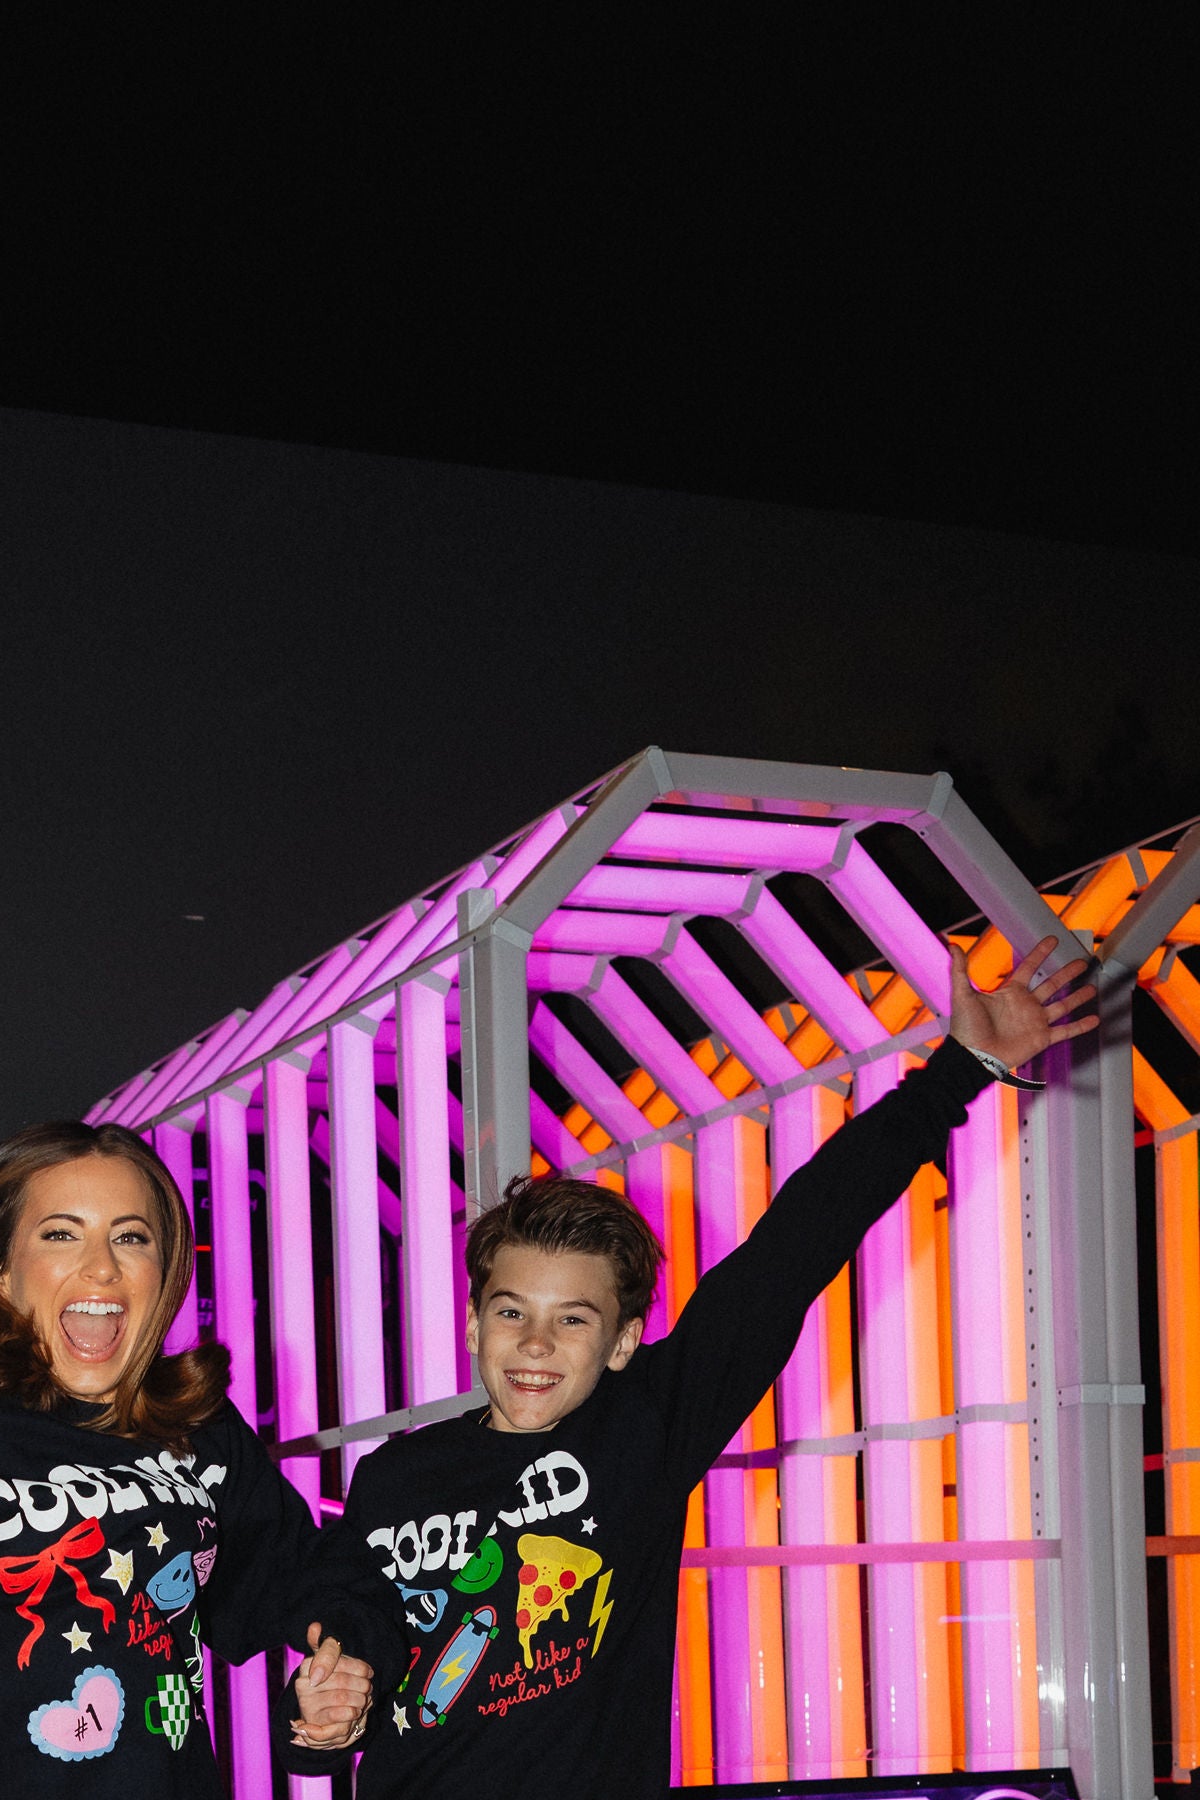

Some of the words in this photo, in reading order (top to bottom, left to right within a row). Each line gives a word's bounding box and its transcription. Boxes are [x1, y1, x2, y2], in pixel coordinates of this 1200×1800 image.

[534, 1640, 571, 1675] like
[576, 1637, 589, 1651] a
[478, 1681, 552, 1717] regular
[553, 1656, 582, 1689] kid
[74, 1703, 103, 1742] #1
